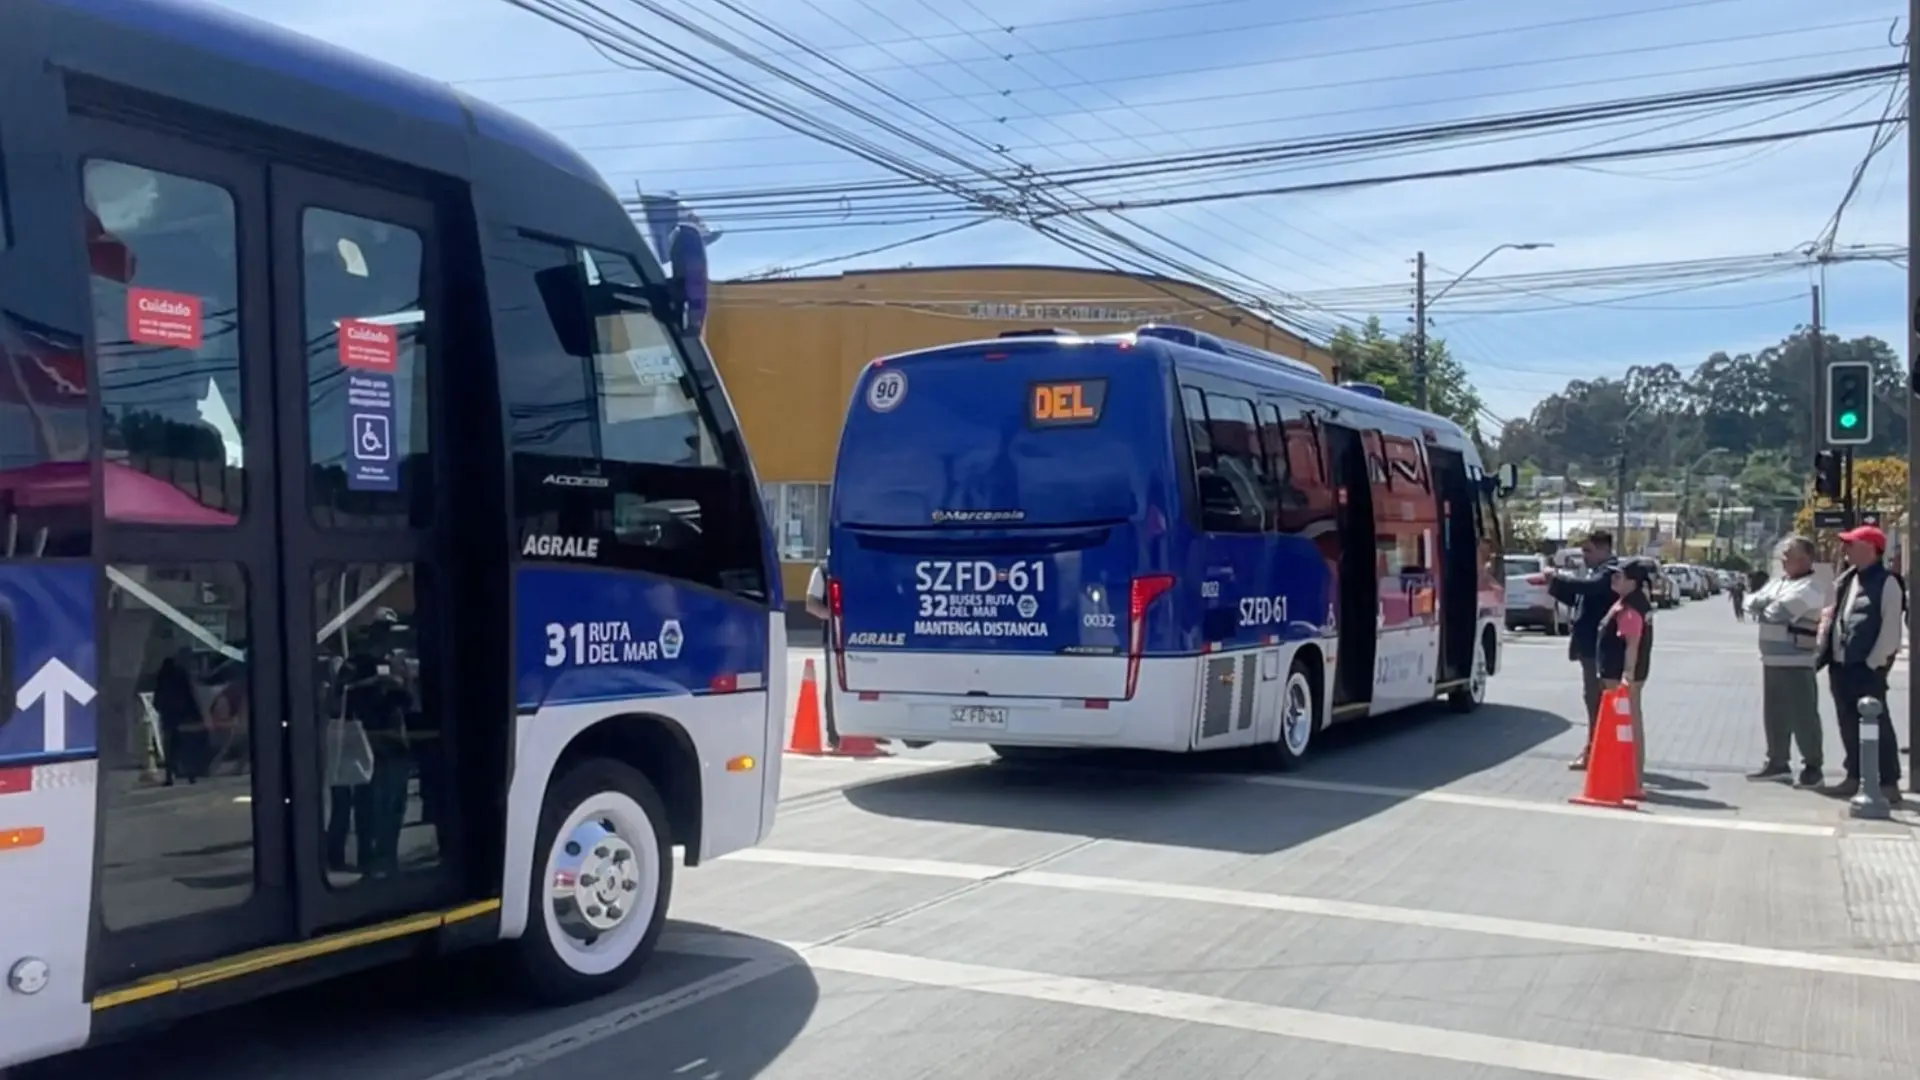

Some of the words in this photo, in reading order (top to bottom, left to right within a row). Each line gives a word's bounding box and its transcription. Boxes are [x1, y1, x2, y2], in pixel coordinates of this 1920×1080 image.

[138, 298, 191, 317] Cuidado
[347, 327, 390, 344] Cuidado
[876, 381, 899, 399] 90
[1035, 384, 1094, 419] DEL
[542, 474, 609, 487] ACCESS
[523, 534, 600, 558] AGRALE
[915, 561, 1045, 592] SZFD-61
[919, 594, 948, 617] 32
[949, 594, 983, 606] BUSES
[985, 594, 1015, 606] RUTA
[949, 606, 970, 618] DEL
[972, 606, 998, 618] MAR
[1083, 614, 1116, 628] 0032
[588, 621, 632, 642] RUTA
[914, 621, 980, 635] MANTENGA
[983, 622, 1048, 637] DISTANCIA
[545, 622, 585, 667] 31
[847, 632, 907, 646] AGRALE
[588, 643, 619, 665] DEL
[623, 641, 658, 662] MAR
